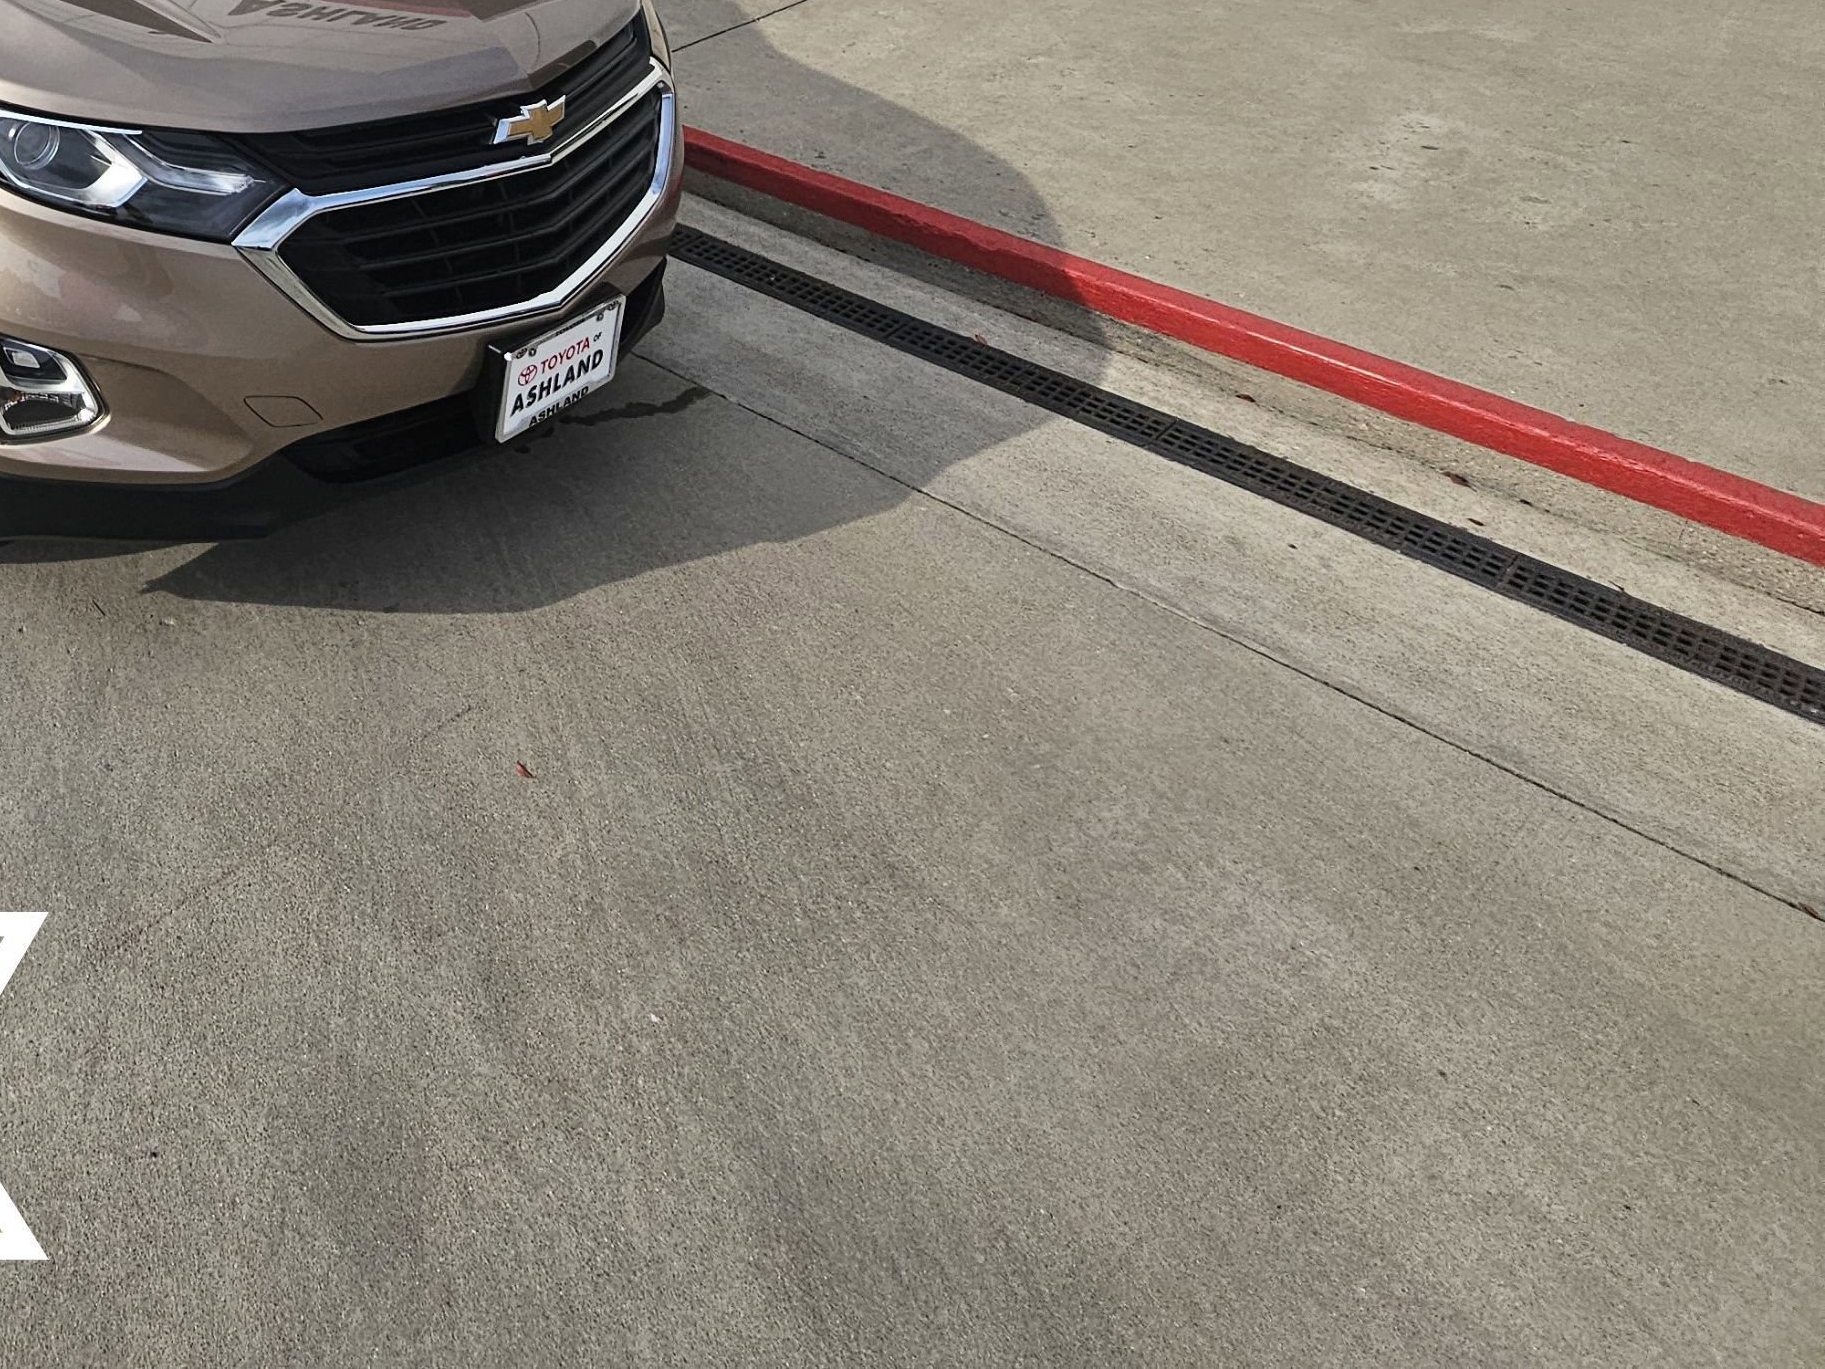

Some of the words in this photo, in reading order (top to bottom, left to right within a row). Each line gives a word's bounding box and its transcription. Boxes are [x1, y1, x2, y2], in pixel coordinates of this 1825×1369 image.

[541, 336, 590, 374] TOYOTA
[510, 349, 604, 417] ASHLAND
[528, 385, 589, 427] ASHLAND
